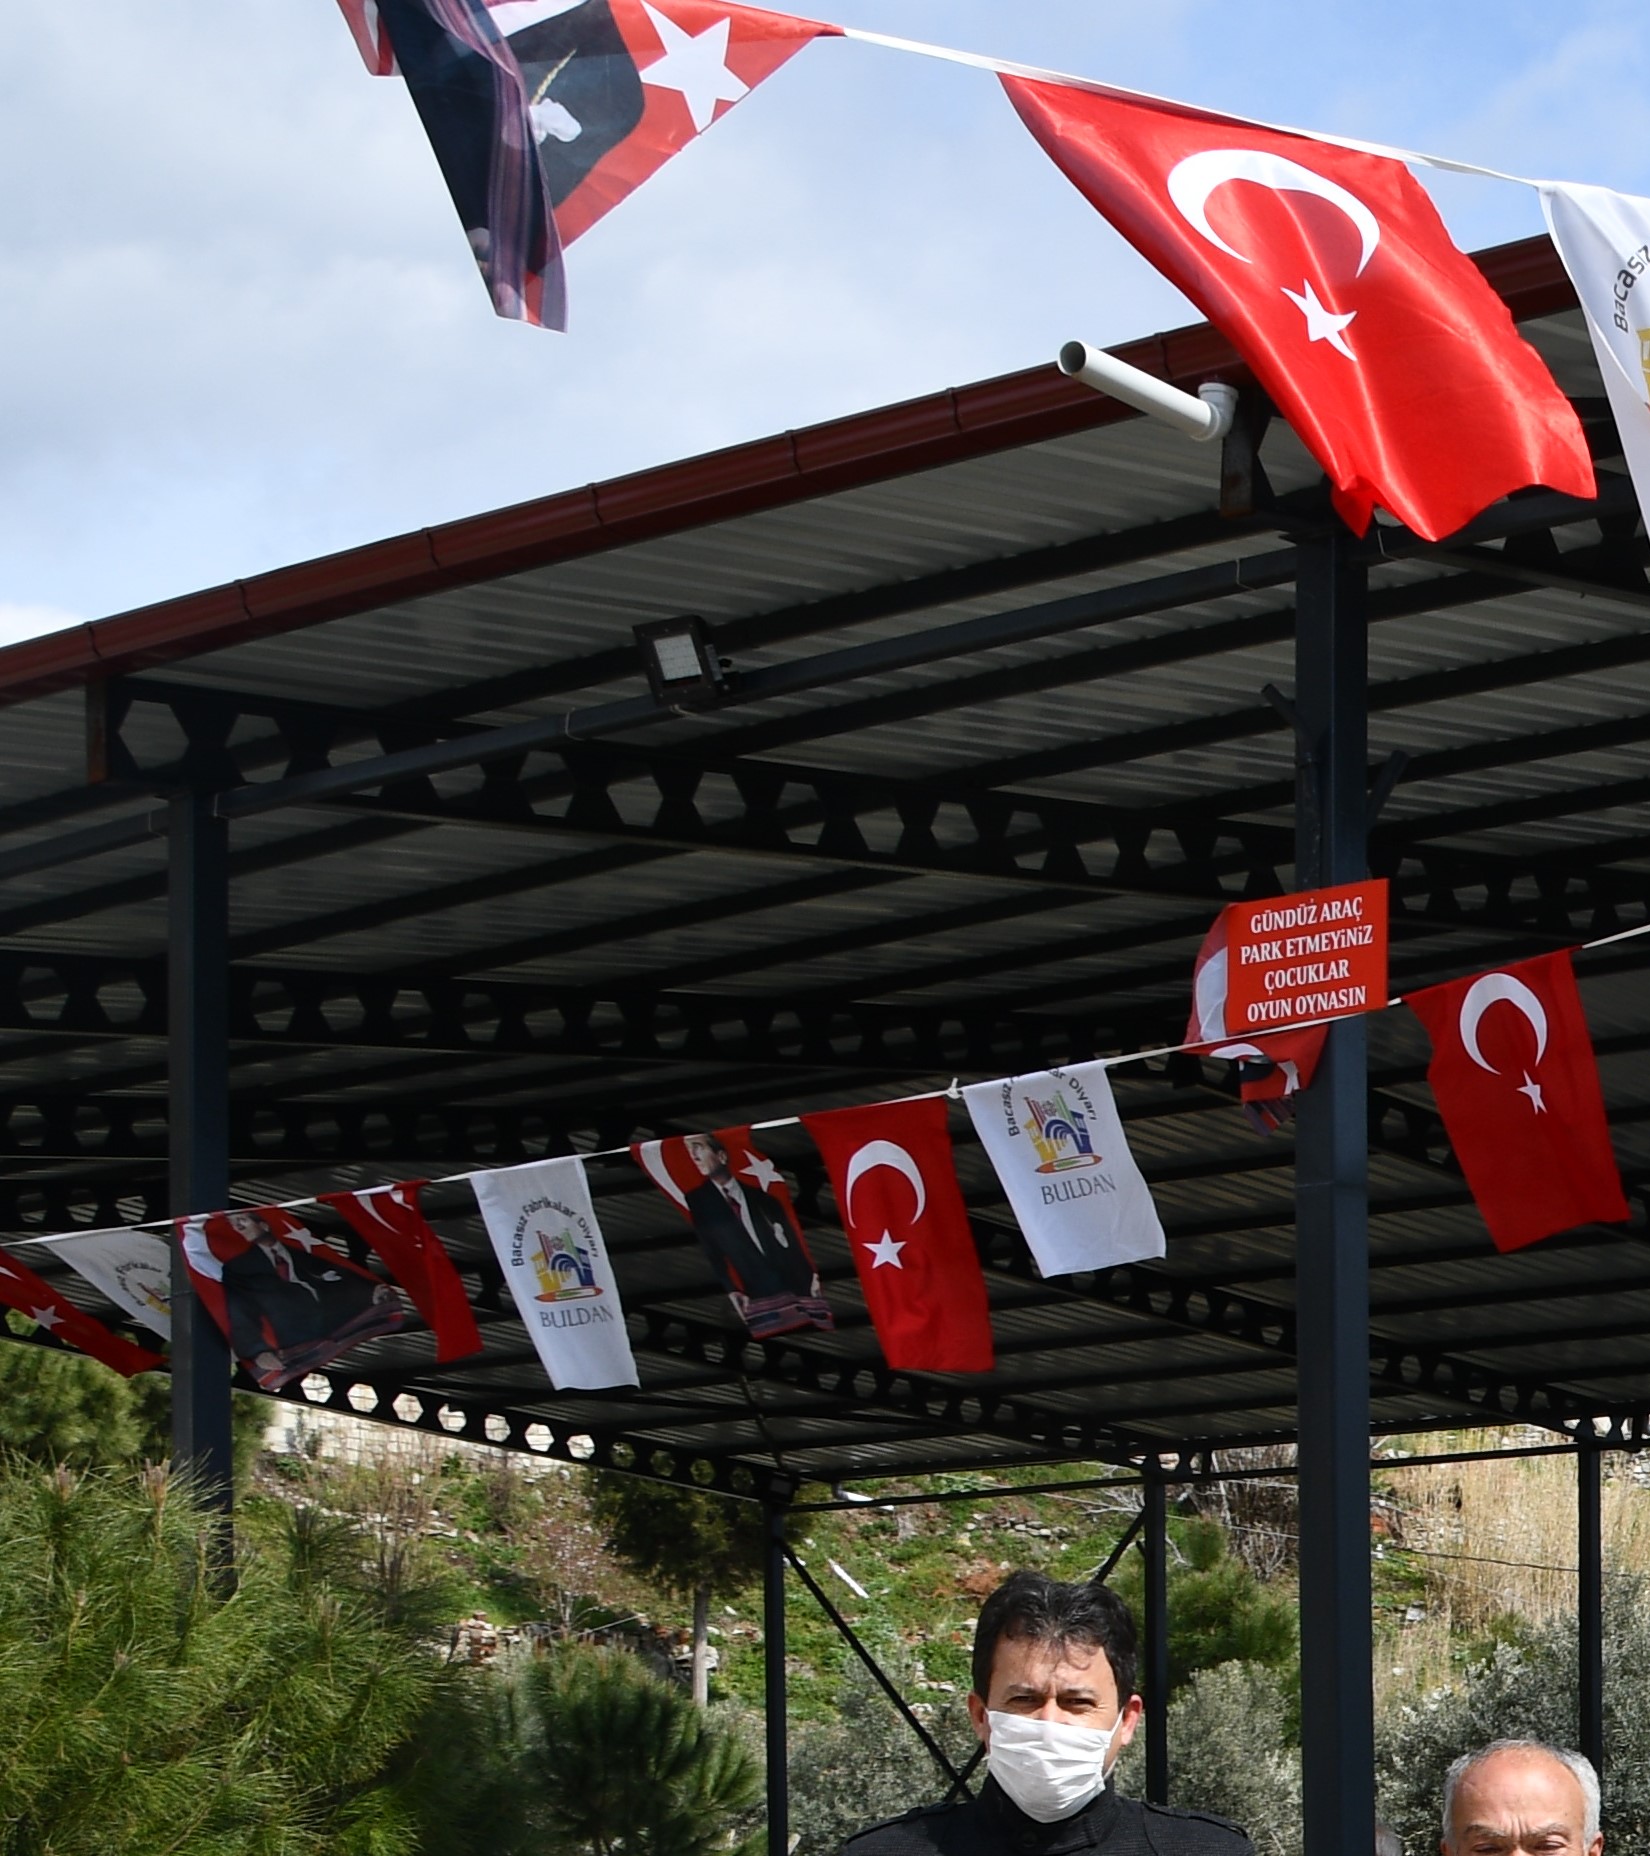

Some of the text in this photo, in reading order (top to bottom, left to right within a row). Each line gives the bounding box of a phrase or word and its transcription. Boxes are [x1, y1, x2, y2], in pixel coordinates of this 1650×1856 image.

[1250, 896, 1363, 934] GÜNDÜZ ARAÇ
[1240, 941, 1284, 965] PARK
[1264, 958, 1350, 995] ÇOCUKLAR
[1247, 985, 1366, 1022] OYUN OYNASIN
[1041, 1173, 1117, 1205] BULDAN
[540, 1305, 614, 1328] BULDAN
